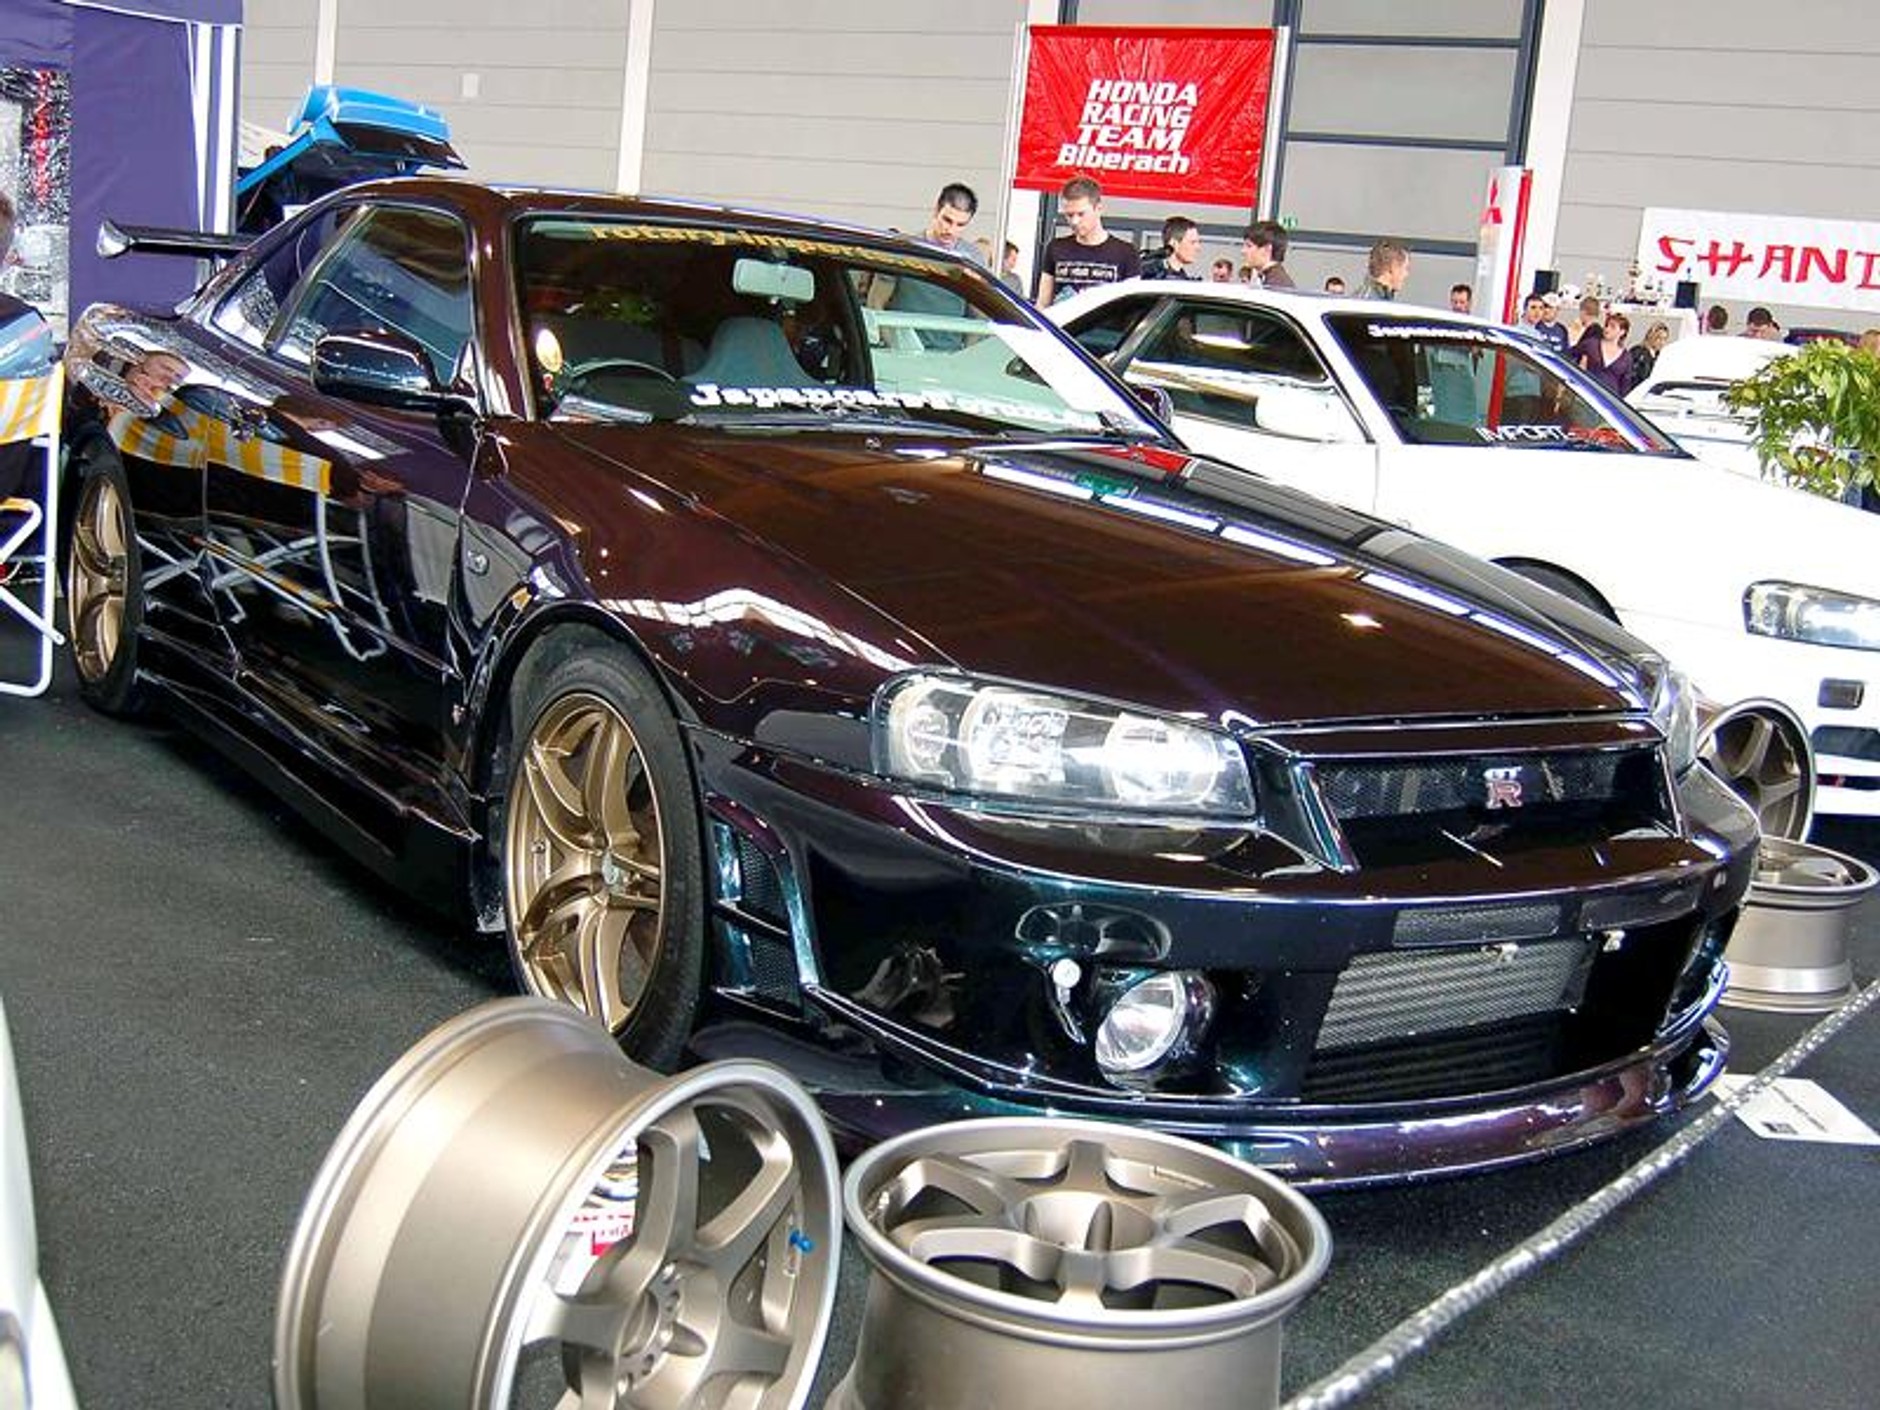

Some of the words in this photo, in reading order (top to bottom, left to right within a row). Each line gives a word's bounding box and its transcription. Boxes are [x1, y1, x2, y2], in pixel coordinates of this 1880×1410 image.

[1087, 79, 1198, 106] HONDA
[1081, 101, 1193, 128] RACING
[1077, 124, 1185, 150] TEAM
[1056, 144, 1190, 174] Biberach
